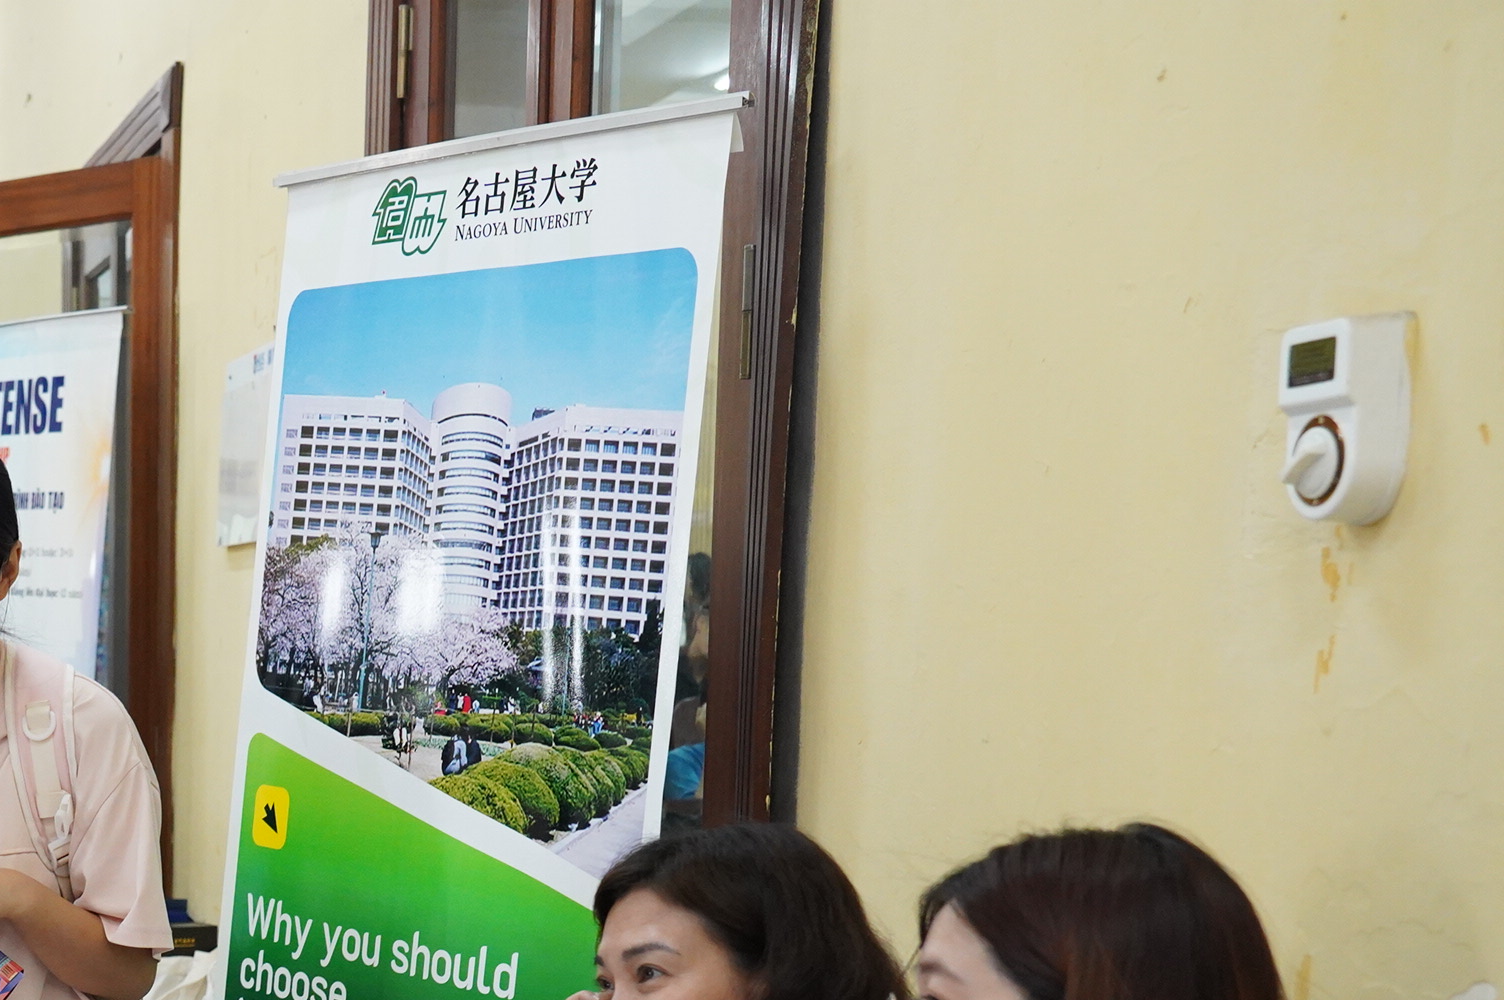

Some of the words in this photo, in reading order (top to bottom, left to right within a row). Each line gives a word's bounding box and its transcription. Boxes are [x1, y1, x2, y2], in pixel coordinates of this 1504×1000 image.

[455, 158, 599, 219] 名古屋大学
[454, 221, 509, 242] NAGOYA
[513, 209, 594, 235] UNIVERSITY
[247, 892, 313, 960] Why
[320, 922, 381, 968] you
[391, 931, 519, 1000] should
